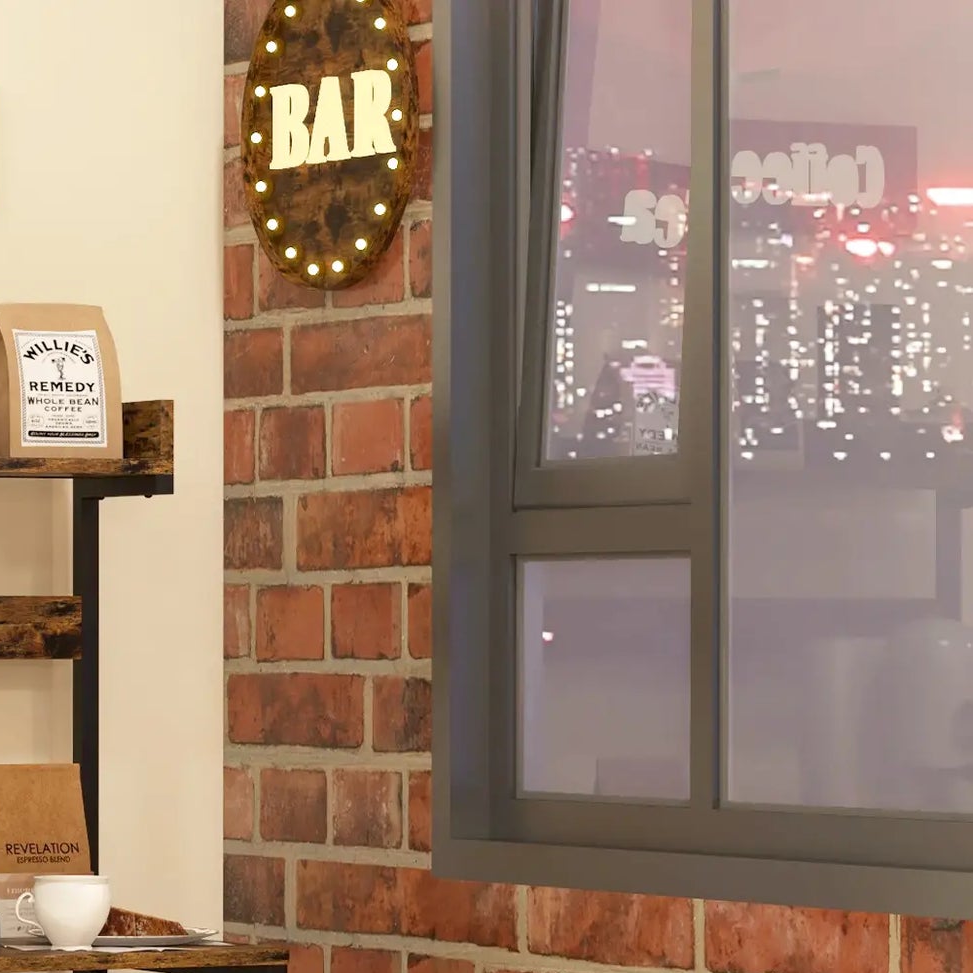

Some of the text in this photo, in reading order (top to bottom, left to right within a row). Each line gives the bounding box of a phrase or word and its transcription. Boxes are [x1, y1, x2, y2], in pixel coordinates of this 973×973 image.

[269, 69, 397, 170] BAR
[23, 339, 95, 365] WILLIE'S
[29, 381, 95, 392] REMEDY
[27, 396, 99, 406] WHOLE BEAN
[5, 842, 80, 855] REVELATION
[17, 855, 71, 864] ESPRESSO BLEND
